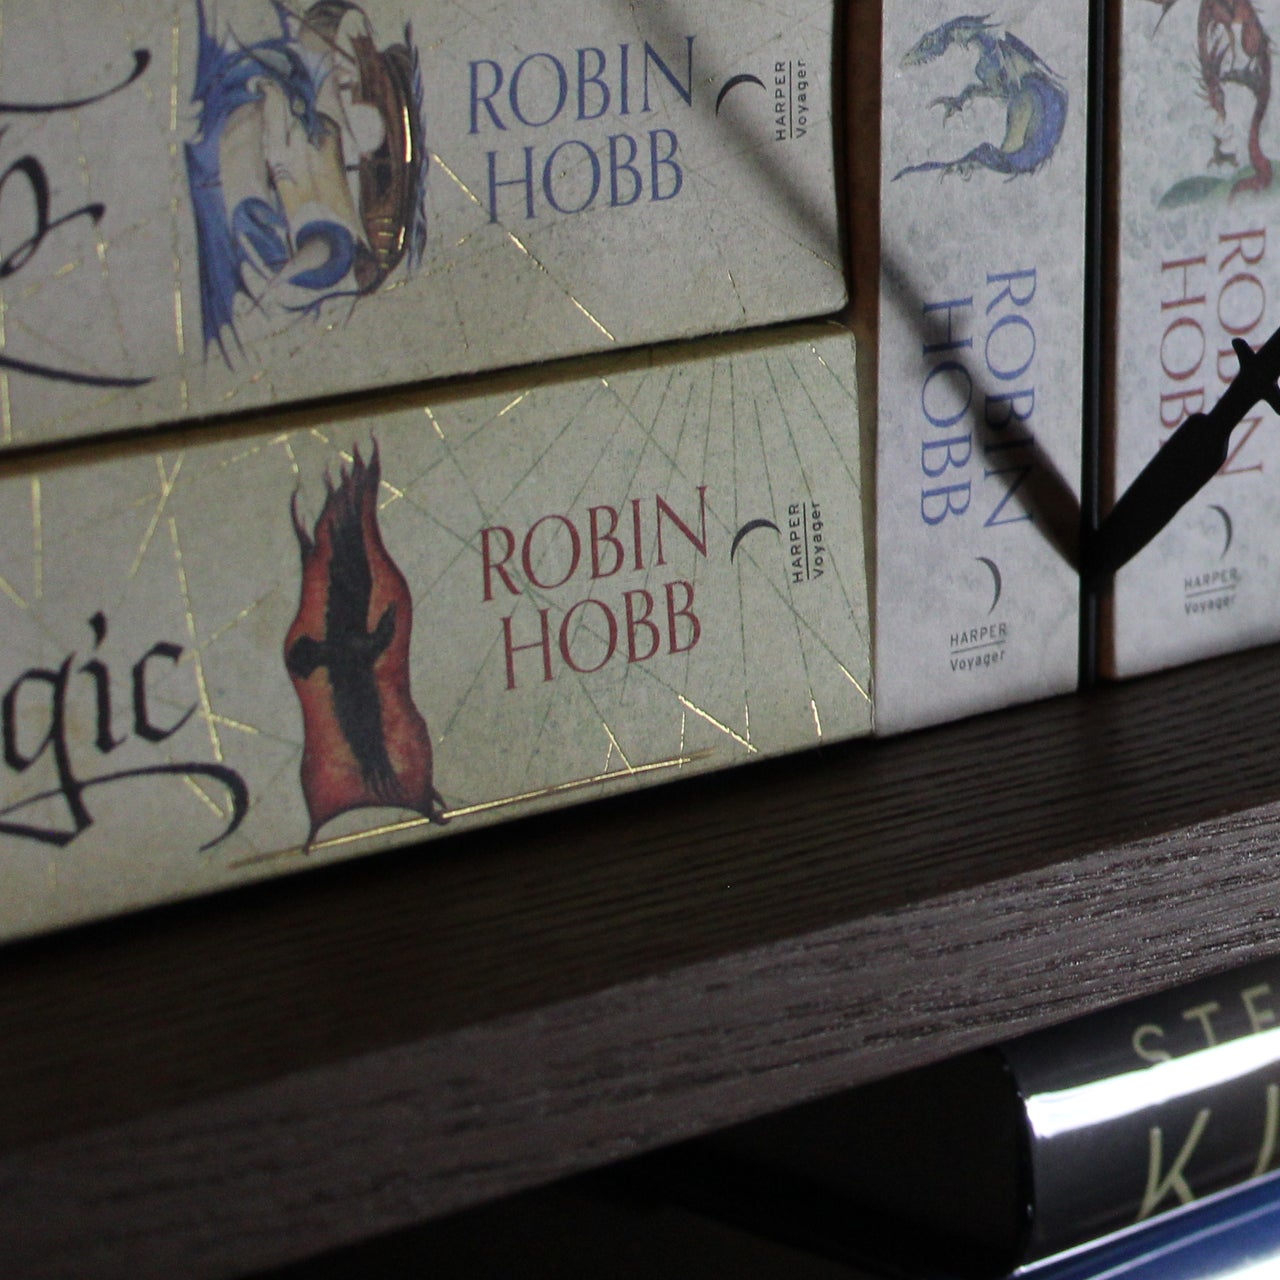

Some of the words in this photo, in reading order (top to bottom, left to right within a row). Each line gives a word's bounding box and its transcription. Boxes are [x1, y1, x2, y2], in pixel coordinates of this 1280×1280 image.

[467, 35, 696, 135] ROBIN
[775, 61, 787, 141] HARPER
[797, 60, 807, 139] Voyager
[486, 128, 683, 224] HOBB
[1149, 255, 1207, 450] HOB
[1216, 228, 1268, 478] ROBN
[920, 296, 973, 526] HOBB
[984, 267, 1037, 529] ROBIN
[480, 486, 709, 603] ROBIN
[789, 503, 804, 584] HARPER
[812, 502, 824, 579] Voyager
[1184, 568, 1238, 592] HARPER
[501, 580, 701, 690] HOBB
[950, 622, 1007, 646] HARPER
[1184, 593, 1236, 617] Voyager
[950, 649, 1006, 673] Voyager
